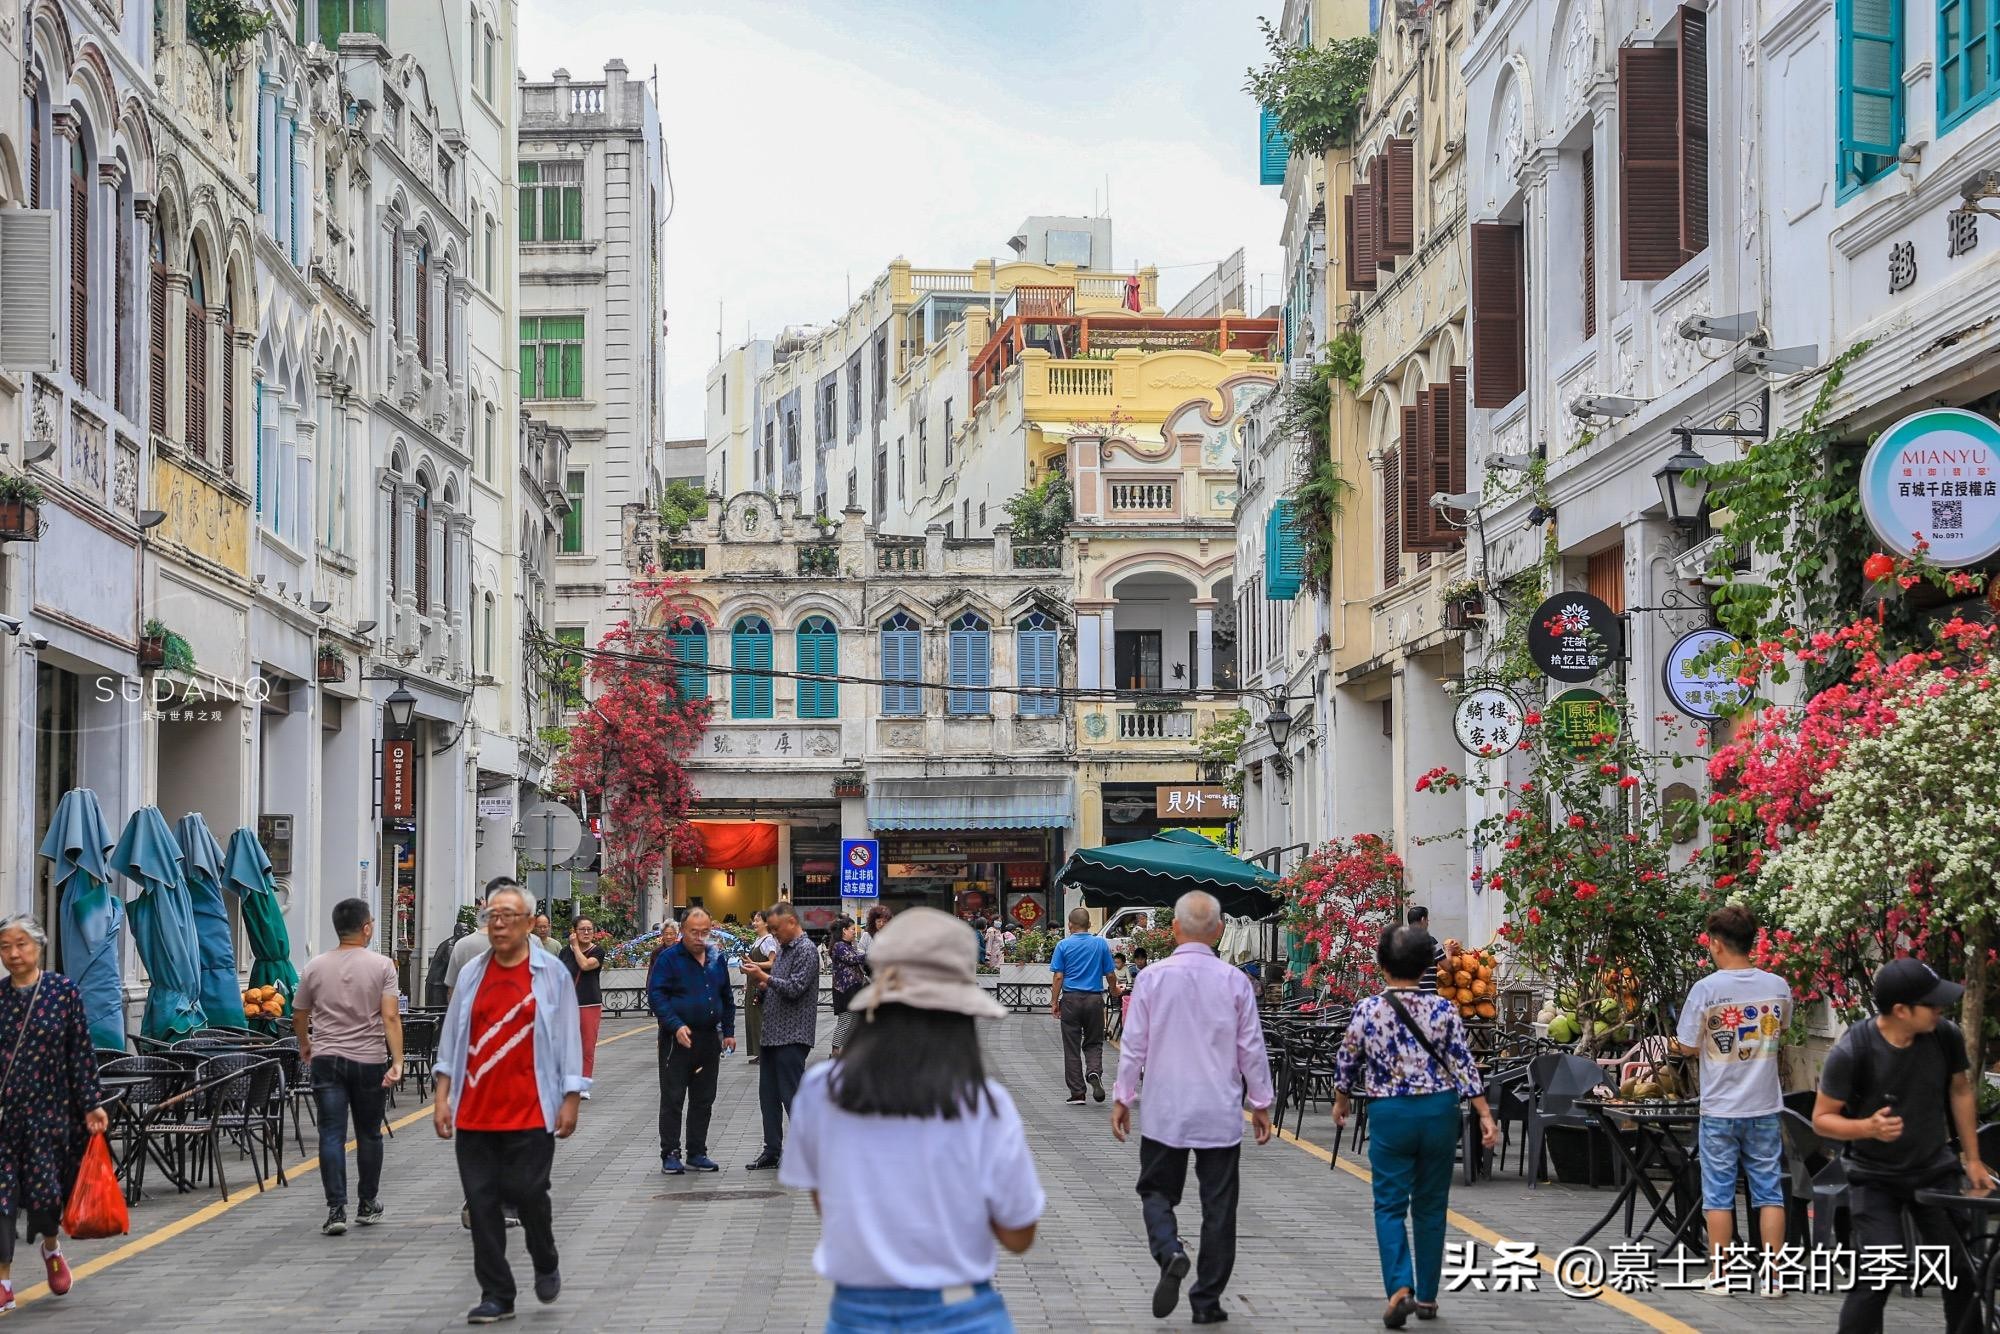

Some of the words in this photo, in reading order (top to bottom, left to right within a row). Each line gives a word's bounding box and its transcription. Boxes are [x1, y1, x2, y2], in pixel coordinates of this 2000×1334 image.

[1902, 449, 1986, 464] MIANYU
[1898, 481, 1996, 497] 百城千店授權店
[1551, 654, 1598, 666] 拾忆民宿
[1569, 718, 1597, 732] 主张
[1166, 790, 1206, 814] 見外
[844, 869, 874, 881] 禁止非机
[843, 882, 874, 894] 动车停放
[1019, 902, 1036, 920] 福
